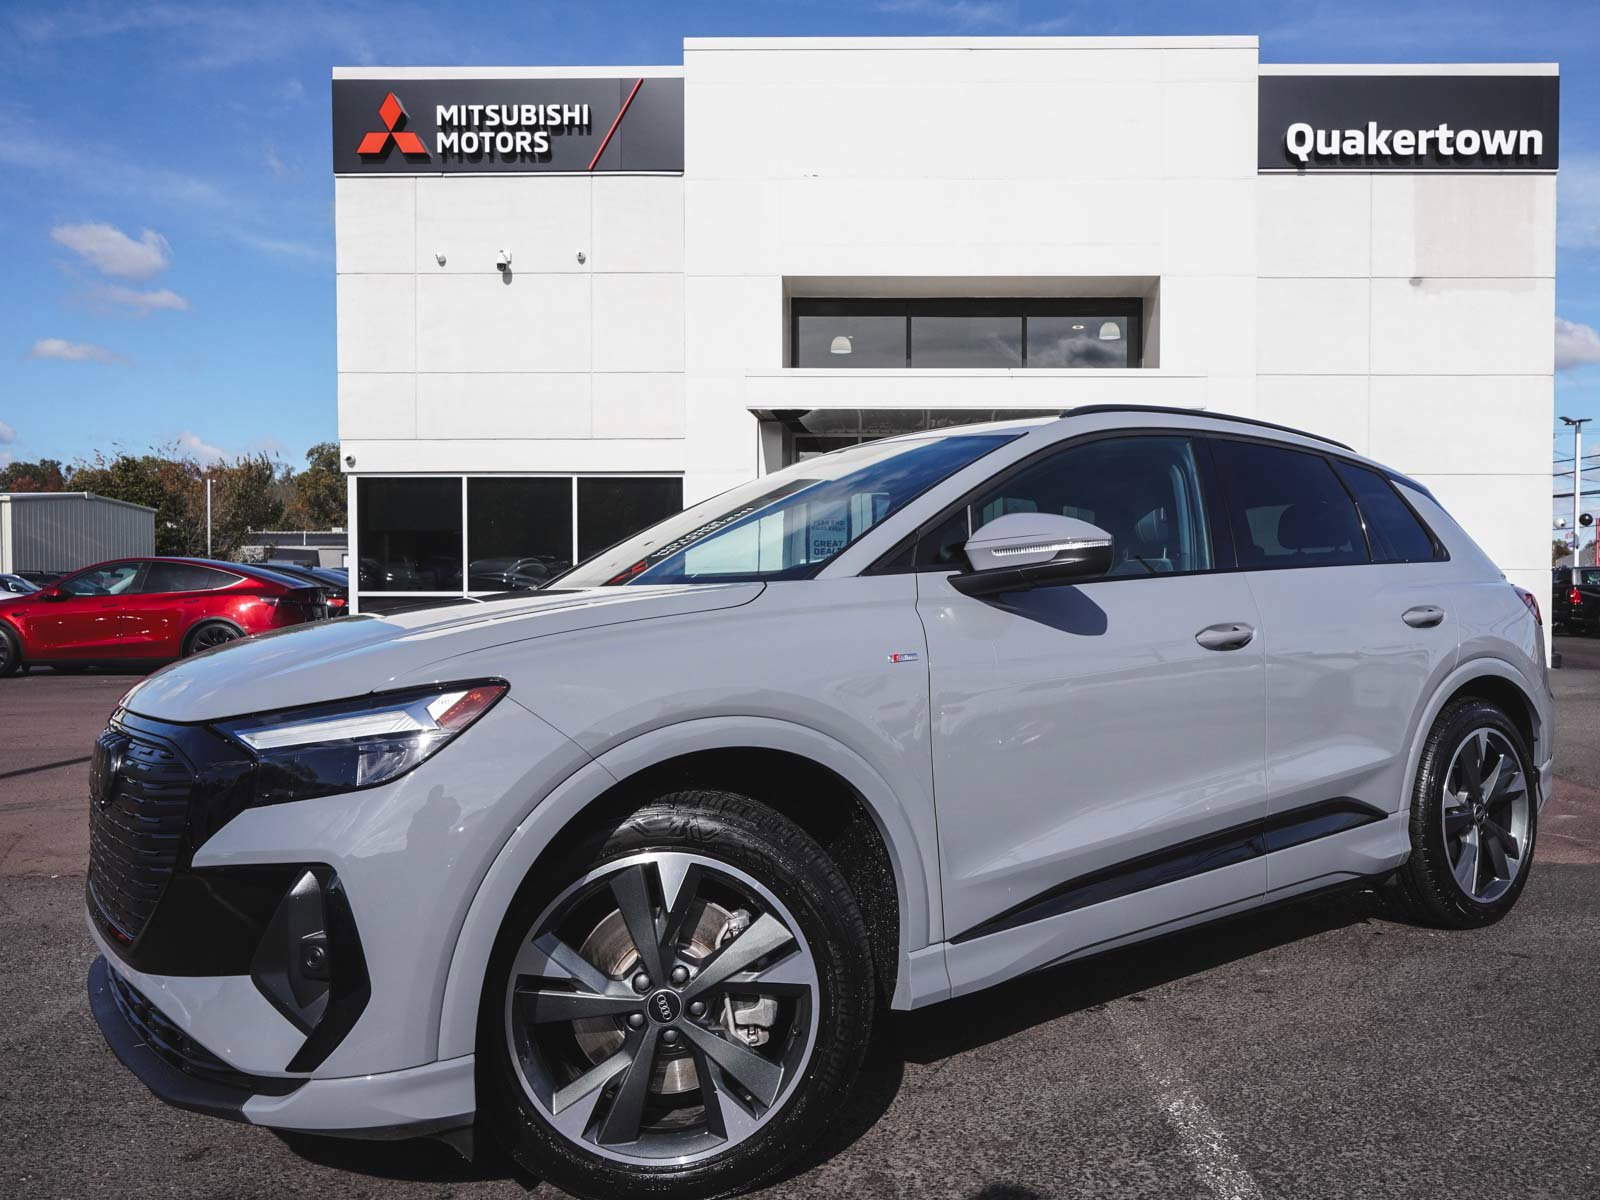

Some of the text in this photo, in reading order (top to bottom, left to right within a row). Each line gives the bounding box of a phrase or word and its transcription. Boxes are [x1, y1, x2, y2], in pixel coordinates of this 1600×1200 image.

[436, 104, 589, 126] MITSUBISHI
[436, 131, 549, 154] MOTORS
[1286, 121, 1543, 161] Quakertown
